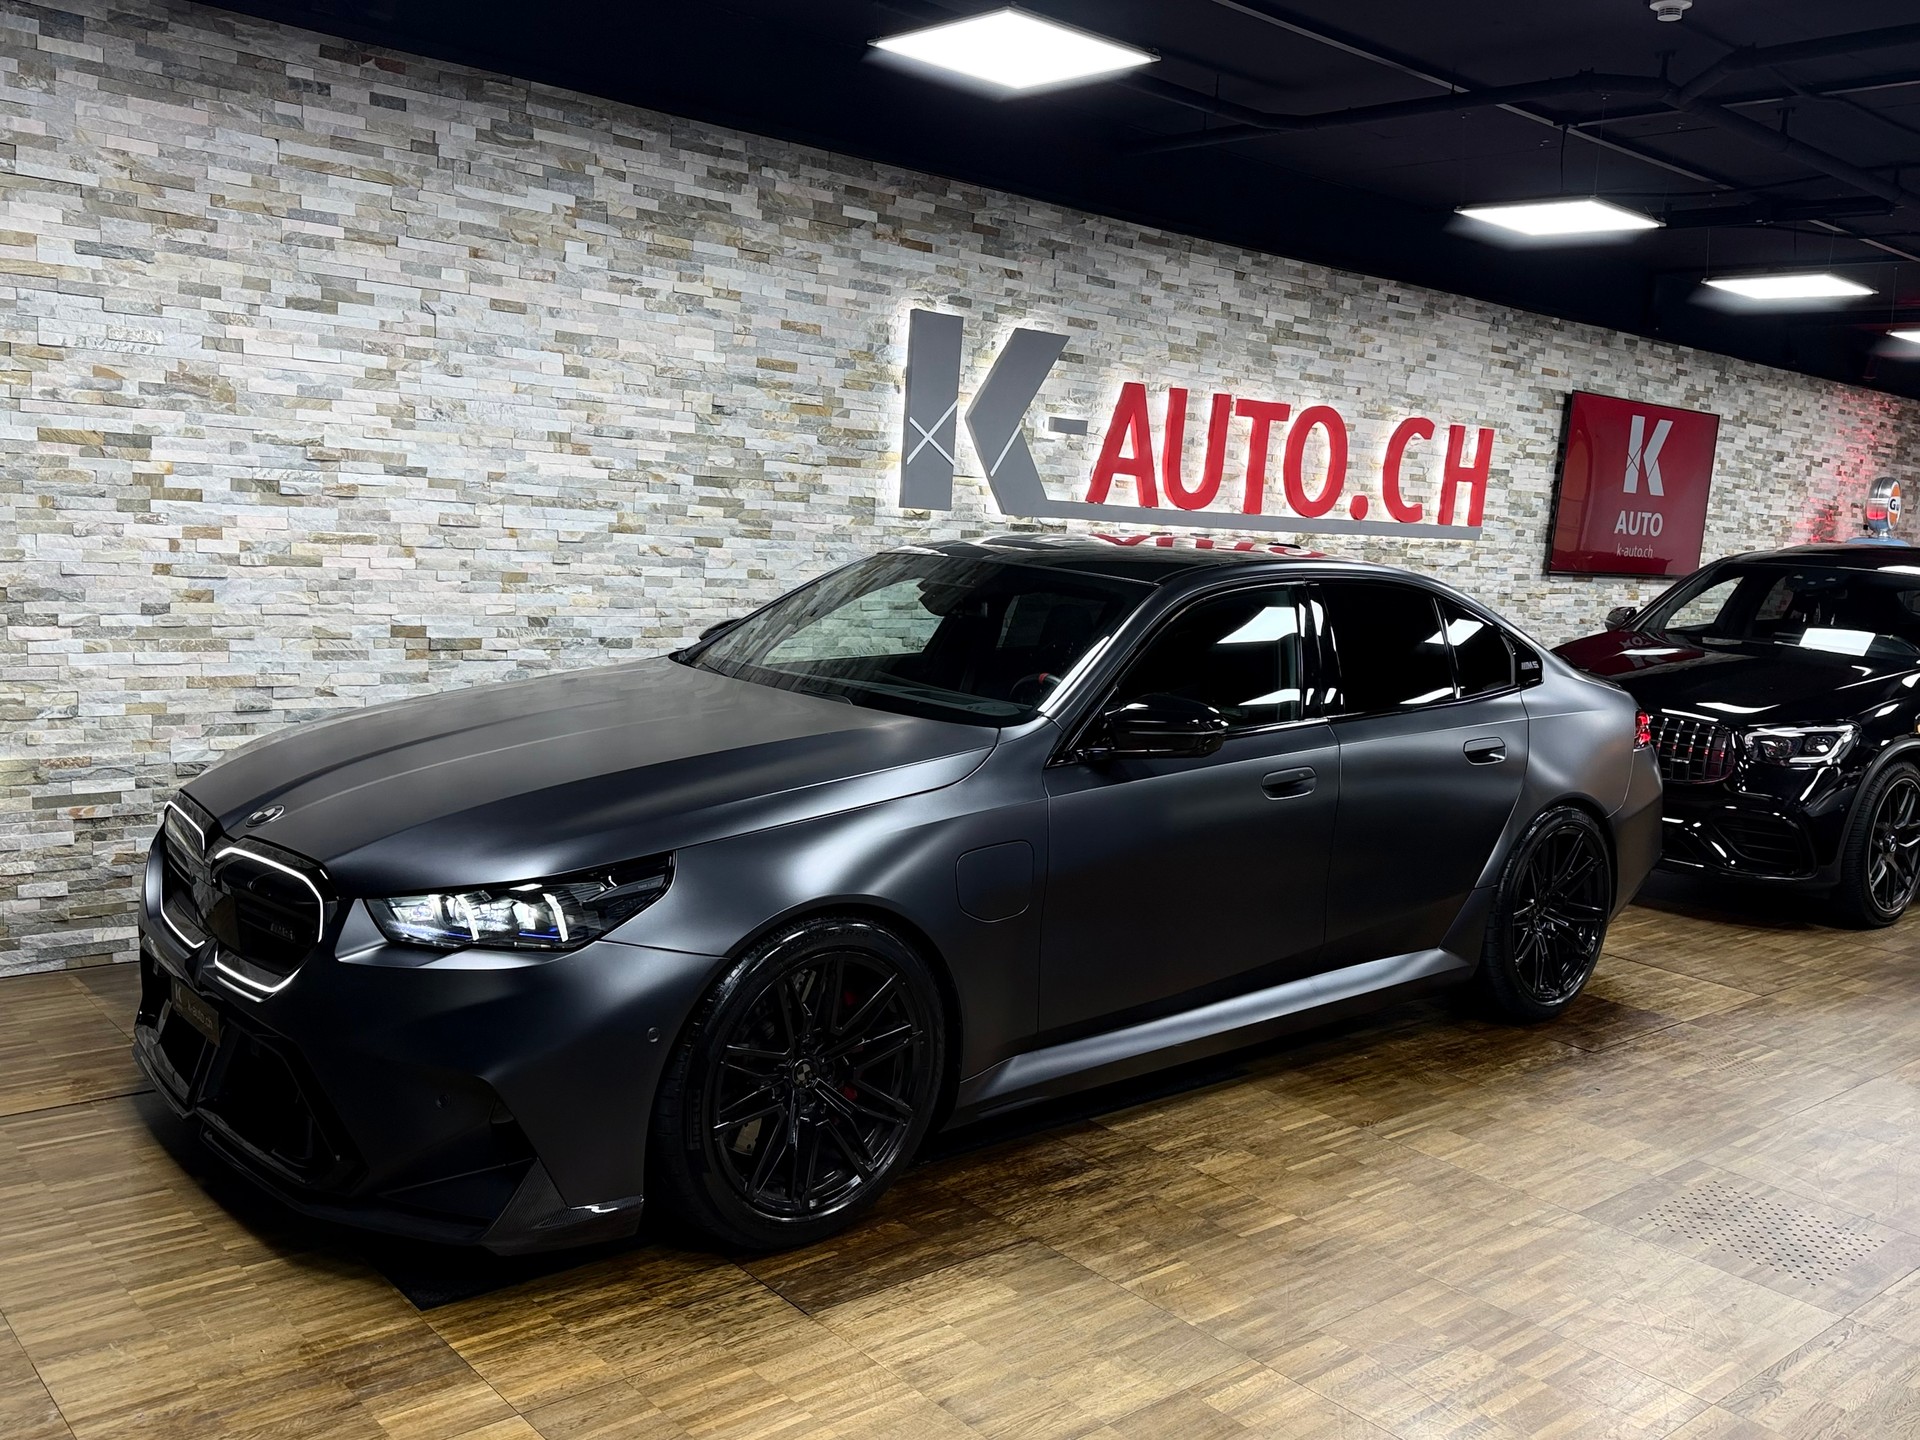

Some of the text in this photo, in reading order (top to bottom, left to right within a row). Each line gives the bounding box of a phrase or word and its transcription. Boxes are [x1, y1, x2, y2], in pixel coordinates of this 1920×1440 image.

[1623, 414, 1673, 497] K
[1614, 510, 1664, 537] AUTO
[1616, 542, 1654, 558] k-auto.ch
